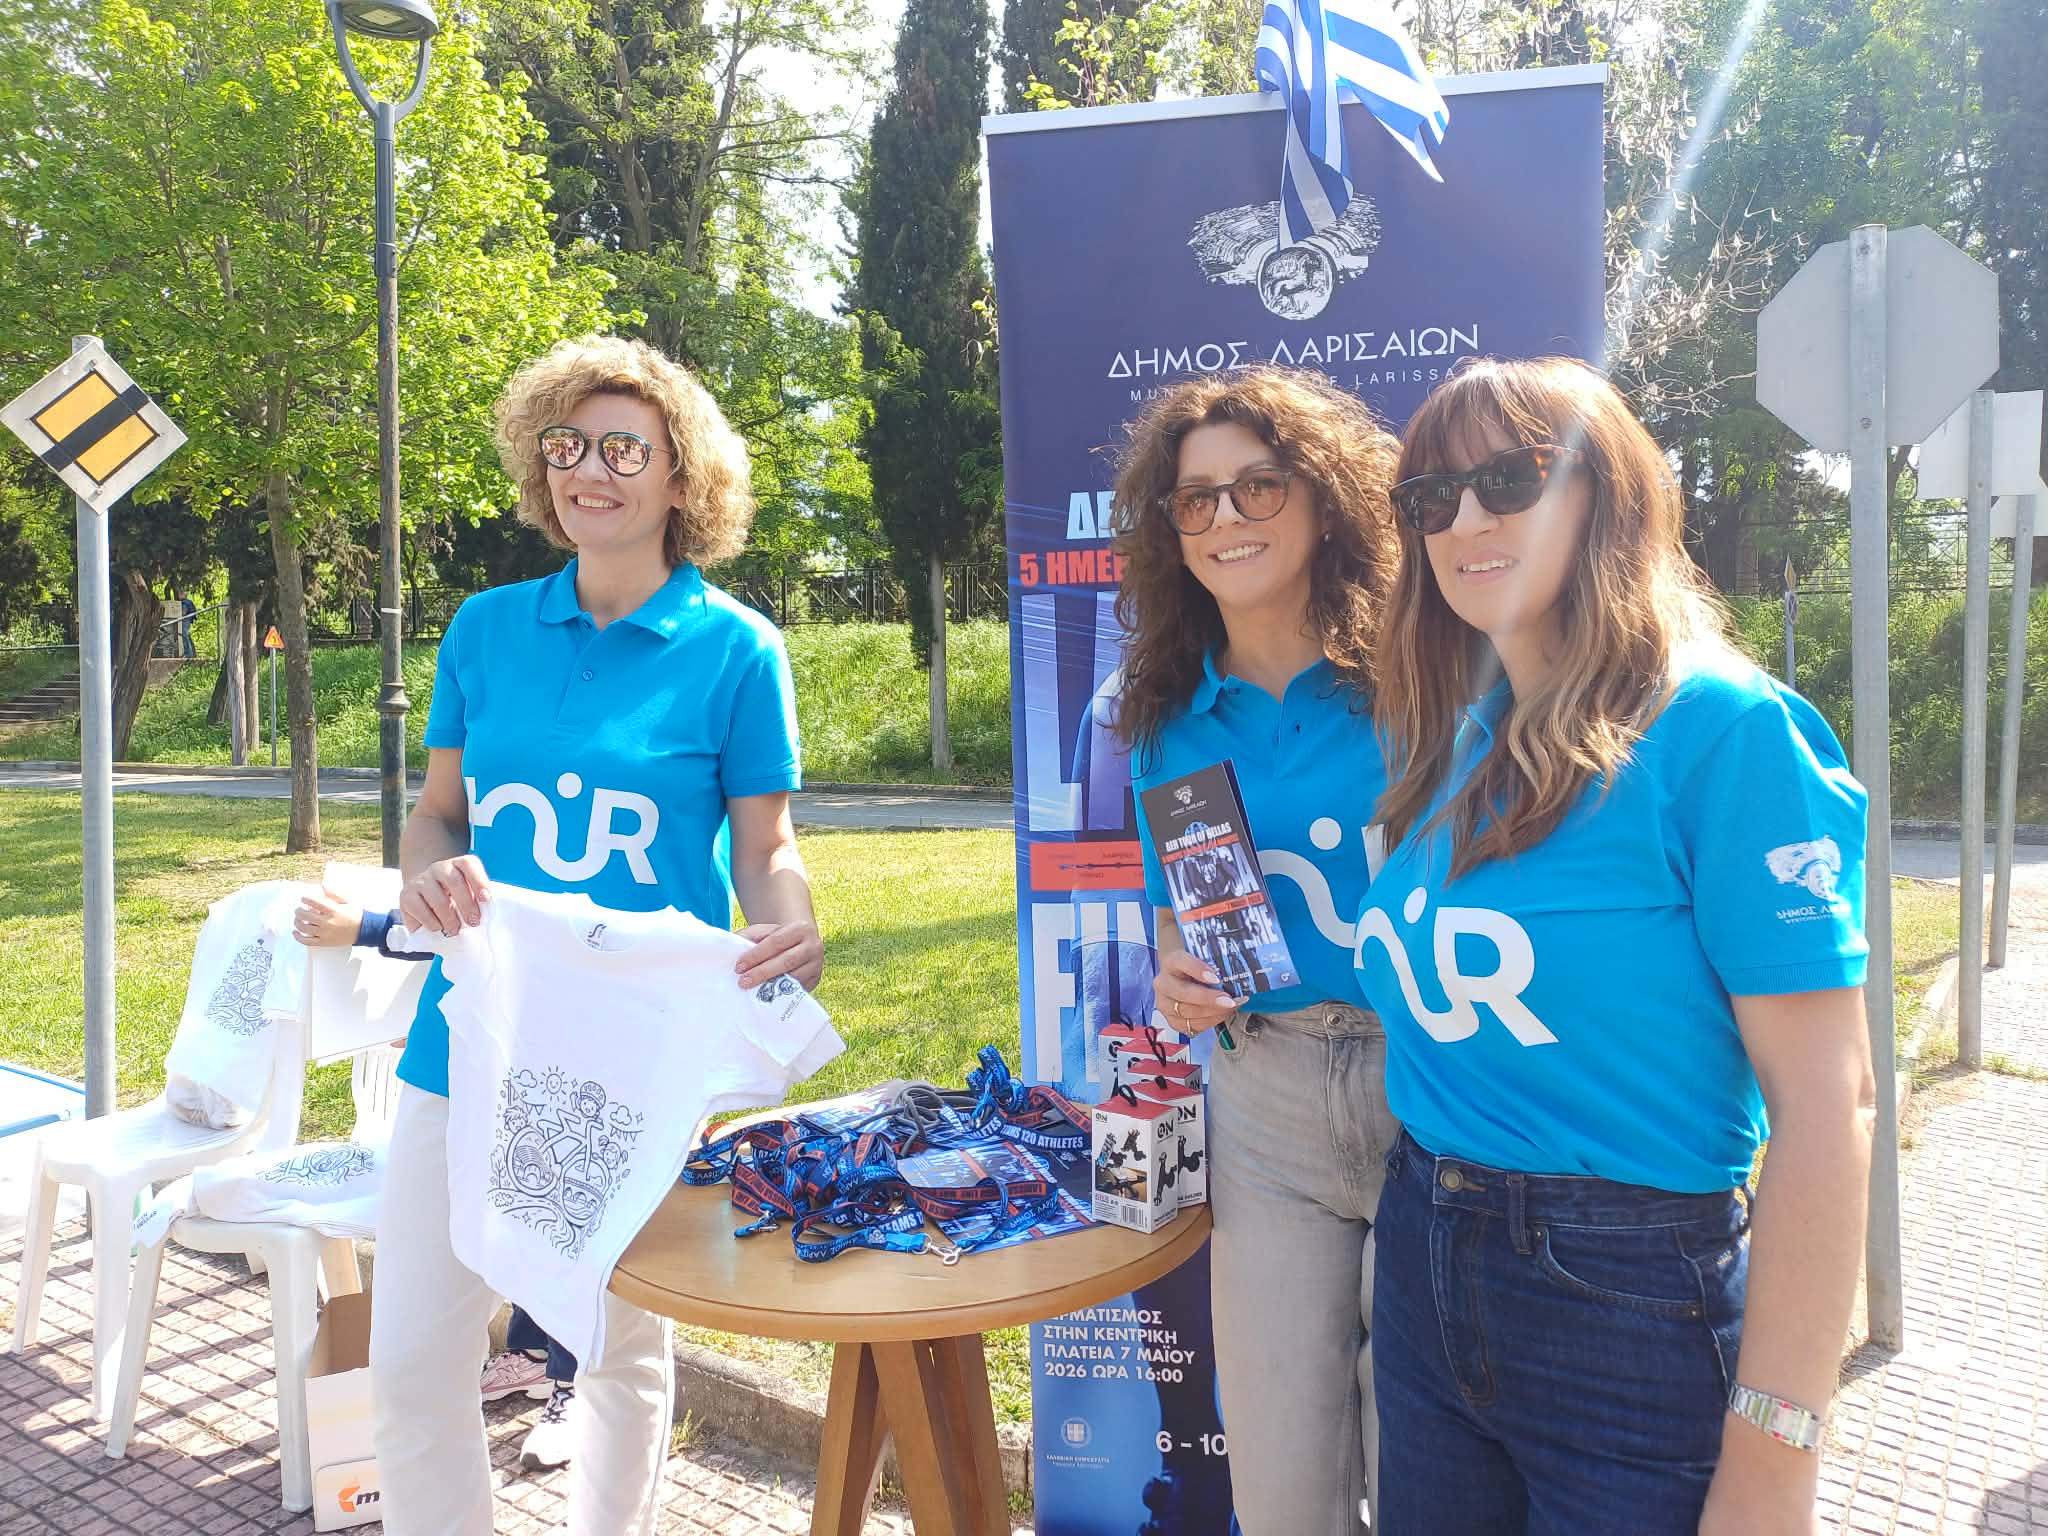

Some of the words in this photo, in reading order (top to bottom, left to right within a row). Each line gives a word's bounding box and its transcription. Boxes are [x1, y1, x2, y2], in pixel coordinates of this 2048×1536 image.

[1107, 341, 1249, 378] ΔΗΜΟΣ
[1270, 323, 1479, 366] ΛΑΡΙΣΑΙΩΝ
[1355, 367, 1456, 386] LARISSA
[1019, 553, 1040, 587] 5
[1022, 1128, 1037, 1145] 120
[1037, 1136, 1084, 1149] ATHLETES
[1050, 1308, 1163, 1325] ΡΜΑΤΙΣΜΟΣ
[1042, 1325, 1089, 1340] ΣΤΗΝ
[1094, 1327, 1177, 1345] ΚΕΝΤΡΙΚΗ
[1043, 1343, 1115, 1360] ΠΛΑΤΕΙΑ
[1120, 1346, 1131, 1360] 7
[1136, 1345, 1196, 1365] ΜΑΪΟΥ
[1044, 1362, 1087, 1378] 2026
[1092, 1364, 1129, 1379] ΩΡΑ
[1136, 1366, 1184, 1383] 16:00
[1155, 1431, 1174, 1453] 6
[1199, 1433, 1229, 1456] 10
